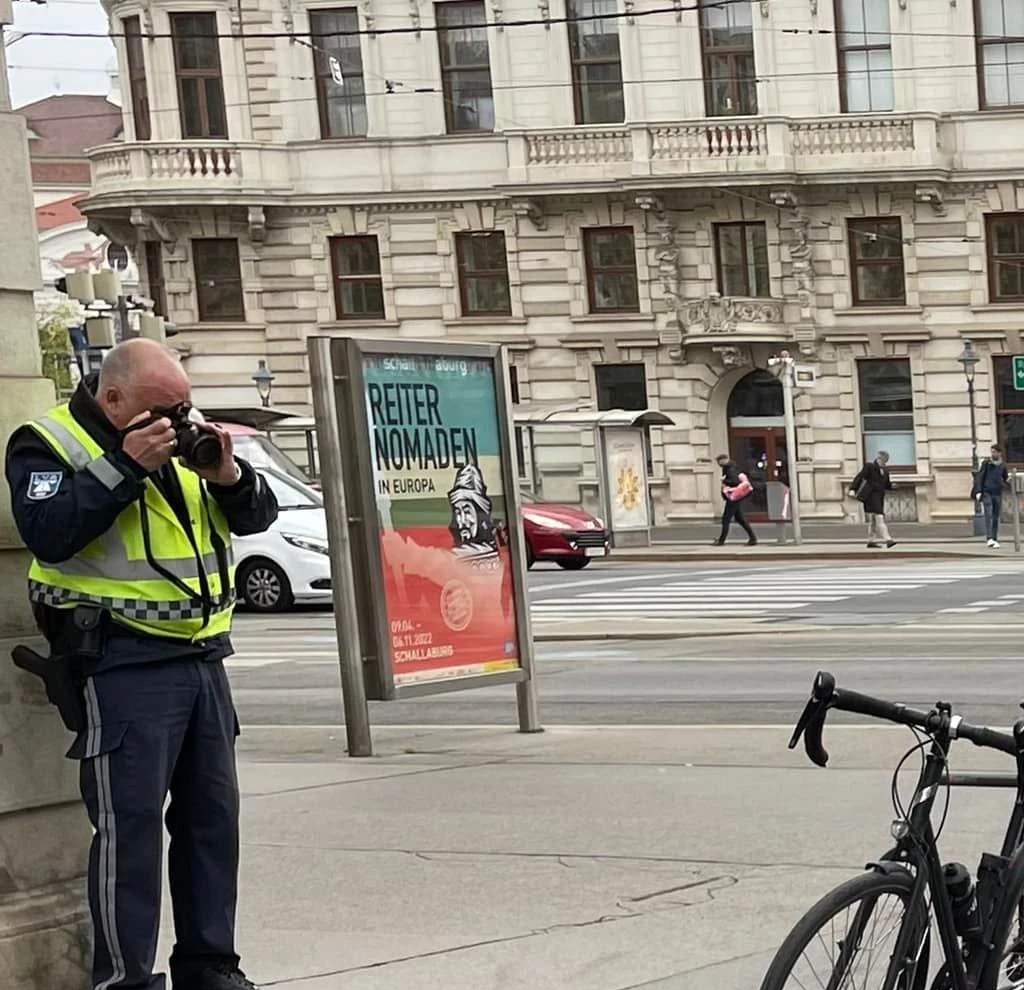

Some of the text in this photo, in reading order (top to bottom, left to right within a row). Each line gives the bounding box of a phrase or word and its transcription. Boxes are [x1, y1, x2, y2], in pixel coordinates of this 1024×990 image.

[368, 382, 443, 426] REITER
[374, 427, 479, 471] NOMADEN
[378, 478, 436, 494] IN EUROPA
[392, 632, 433, 648] 06.11.2022
[394, 645, 454, 664] SCHALLABURG
